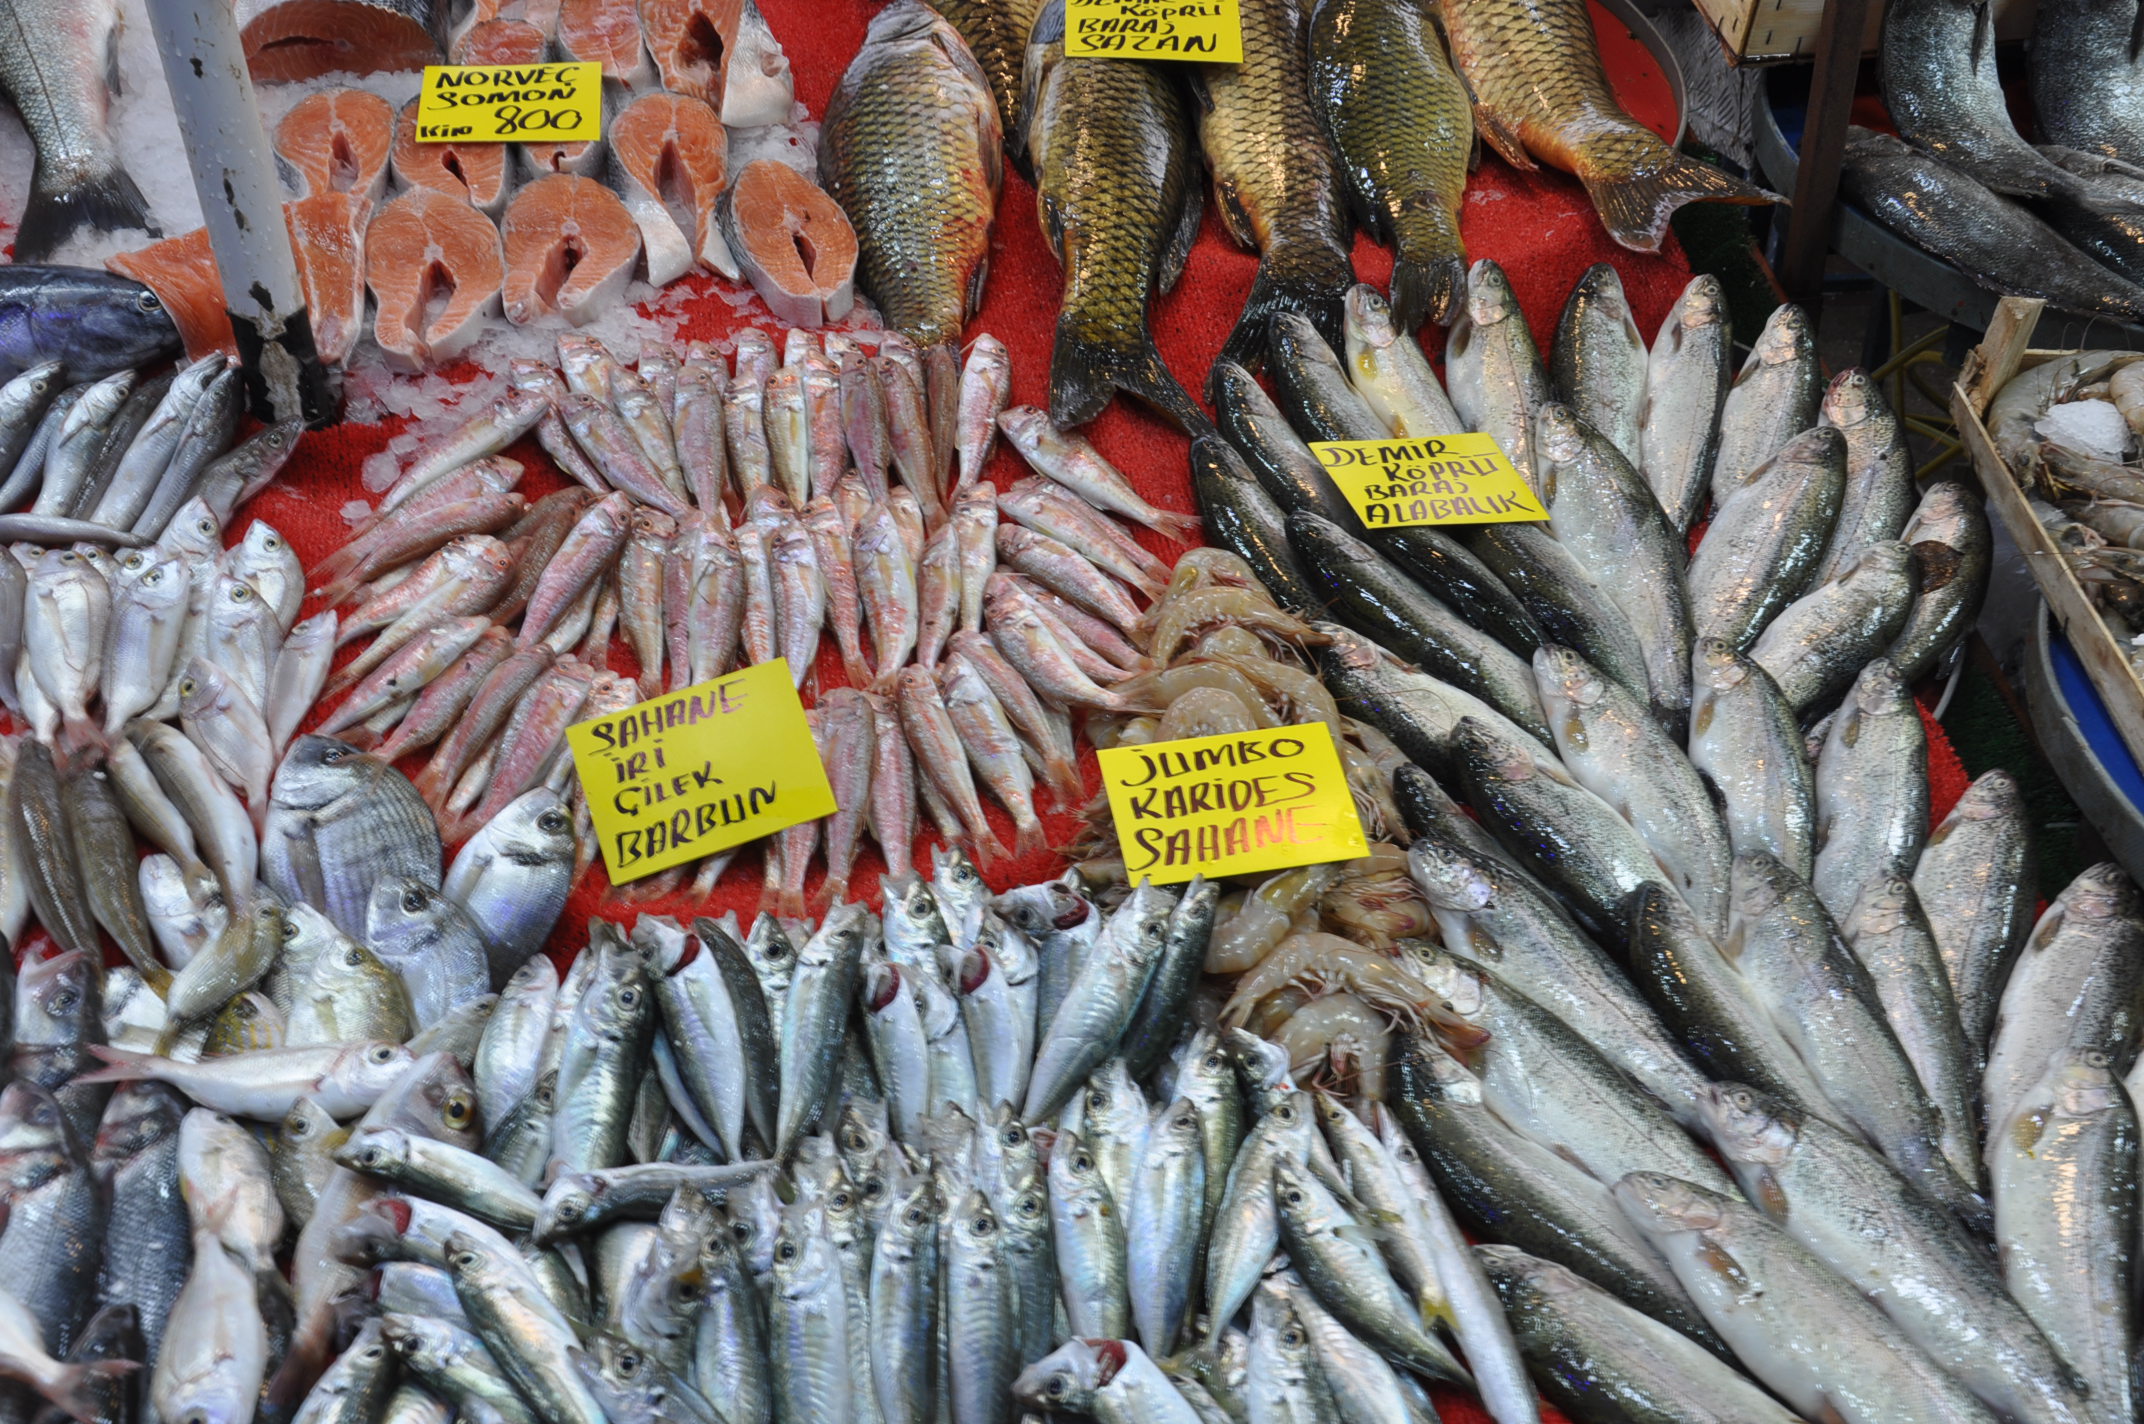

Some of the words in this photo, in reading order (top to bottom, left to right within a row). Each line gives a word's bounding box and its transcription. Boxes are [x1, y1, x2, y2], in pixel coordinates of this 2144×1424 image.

[1078, 18, 1175, 35] BARAJ
[1072, 33, 1217, 53] SAZAN
[436, 66, 580, 88] NORVEÇ
[427, 87, 576, 110] SOMON
[494, 105, 582, 135] 800
[1320, 439, 1459, 467] DEMİR
[1381, 452, 1498, 482] KÖPRÜ
[1364, 478, 1469, 501] BARAJ
[1365, 490, 1535, 524] ALABALIK
[611, 739, 666, 783] İRİ
[1120, 738, 1304, 787] JUMBO
[613, 760, 723, 817] ÇİLEK
[1130, 772, 1316, 819] KARİDES
[615, 780, 776, 868] BARBUN
